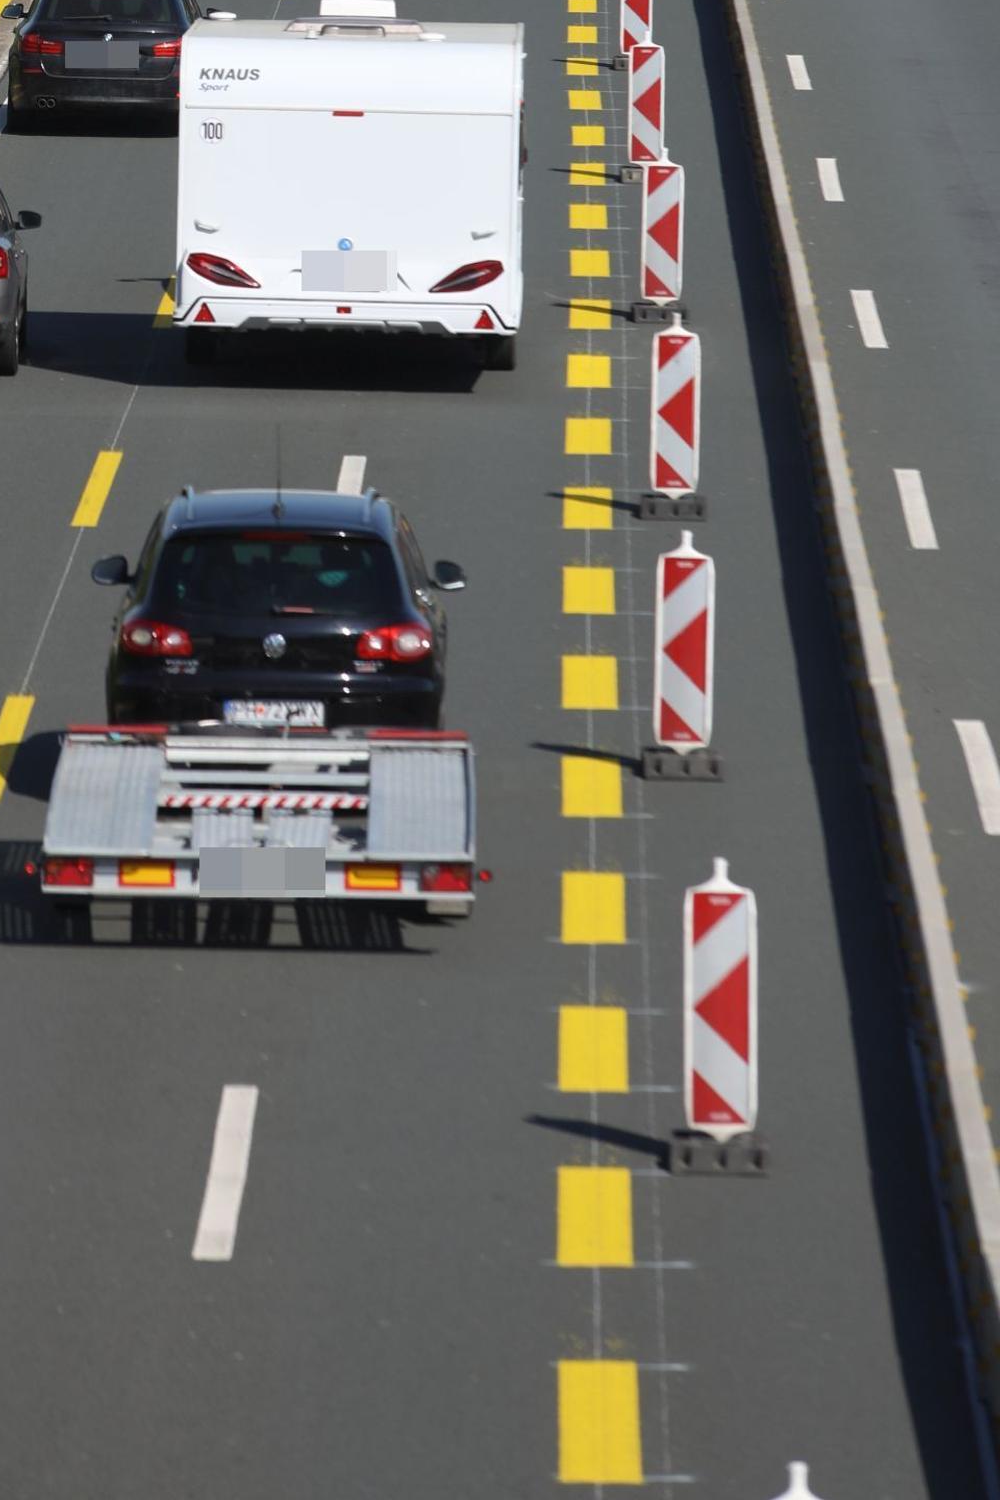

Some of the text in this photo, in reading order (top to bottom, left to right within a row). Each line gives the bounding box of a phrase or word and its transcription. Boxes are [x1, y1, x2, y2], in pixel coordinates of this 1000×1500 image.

[199, 68, 260, 81] KNAUS
[198, 83, 229, 92] Sport
[202, 122, 223, 140] 100
